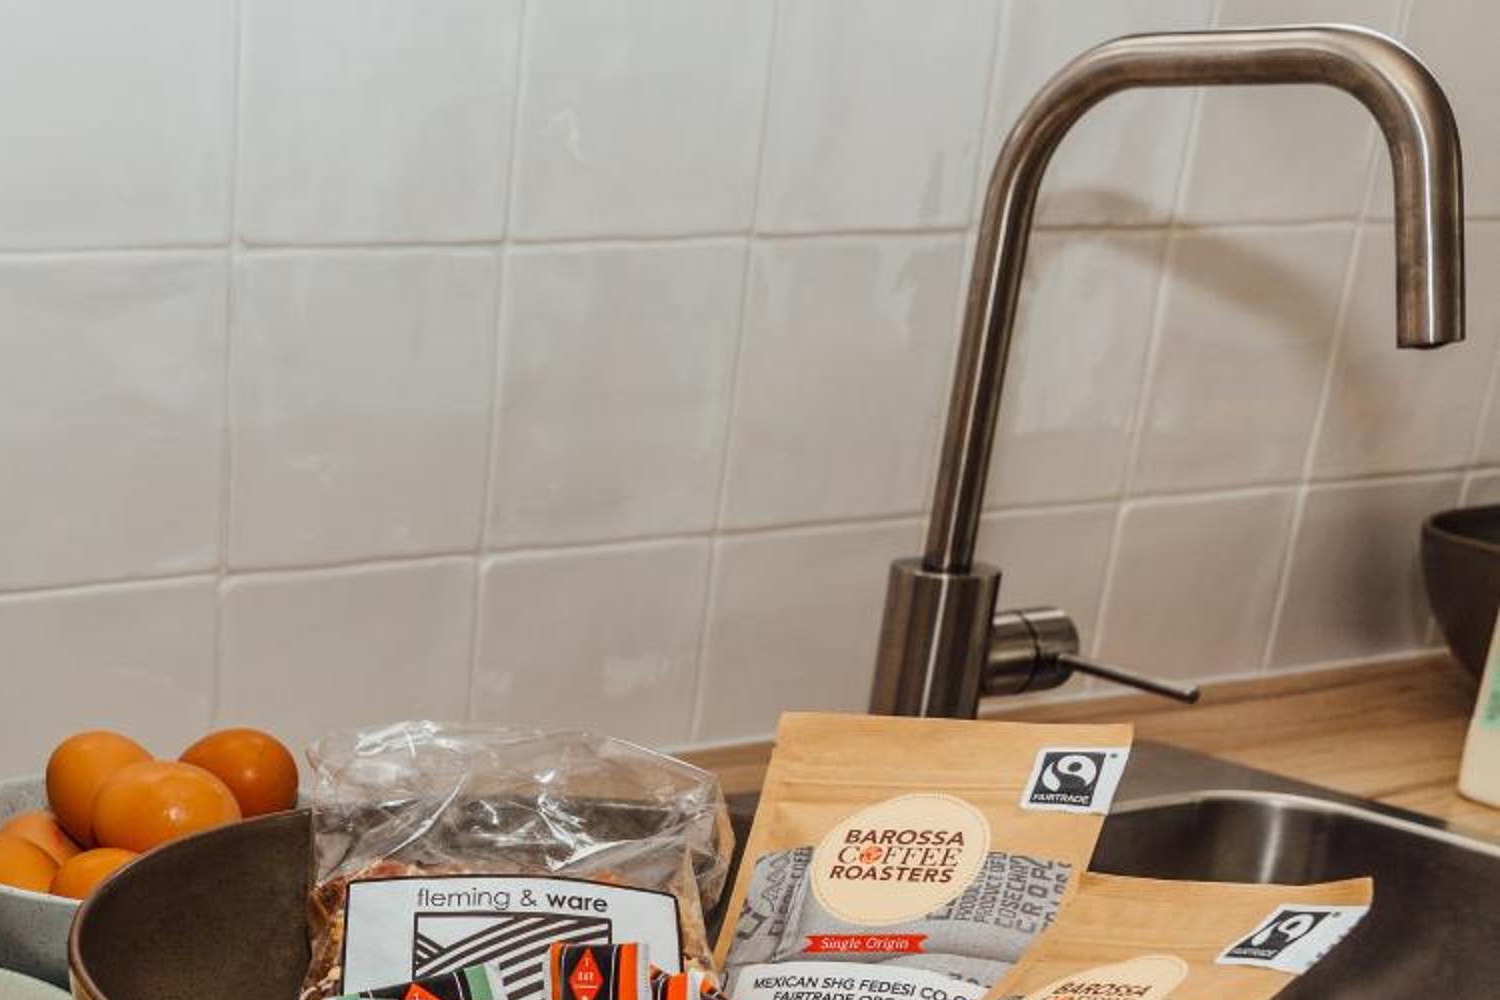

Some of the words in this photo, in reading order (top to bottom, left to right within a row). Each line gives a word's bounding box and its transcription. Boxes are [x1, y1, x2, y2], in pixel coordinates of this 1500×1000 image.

[844, 829, 965, 846] BAROSSA
[829, 865, 955, 883] ROASTERS
[416, 887, 511, 911] fleming
[519, 888, 538, 907] &
[546, 893, 609, 913] ware
[820, 937, 861, 951] Single
[865, 937, 909, 951] Origin
[753, 974, 819, 990] MEXICAN
[821, 976, 856, 991] SHG
[859, 978, 916, 997] FEDESI
